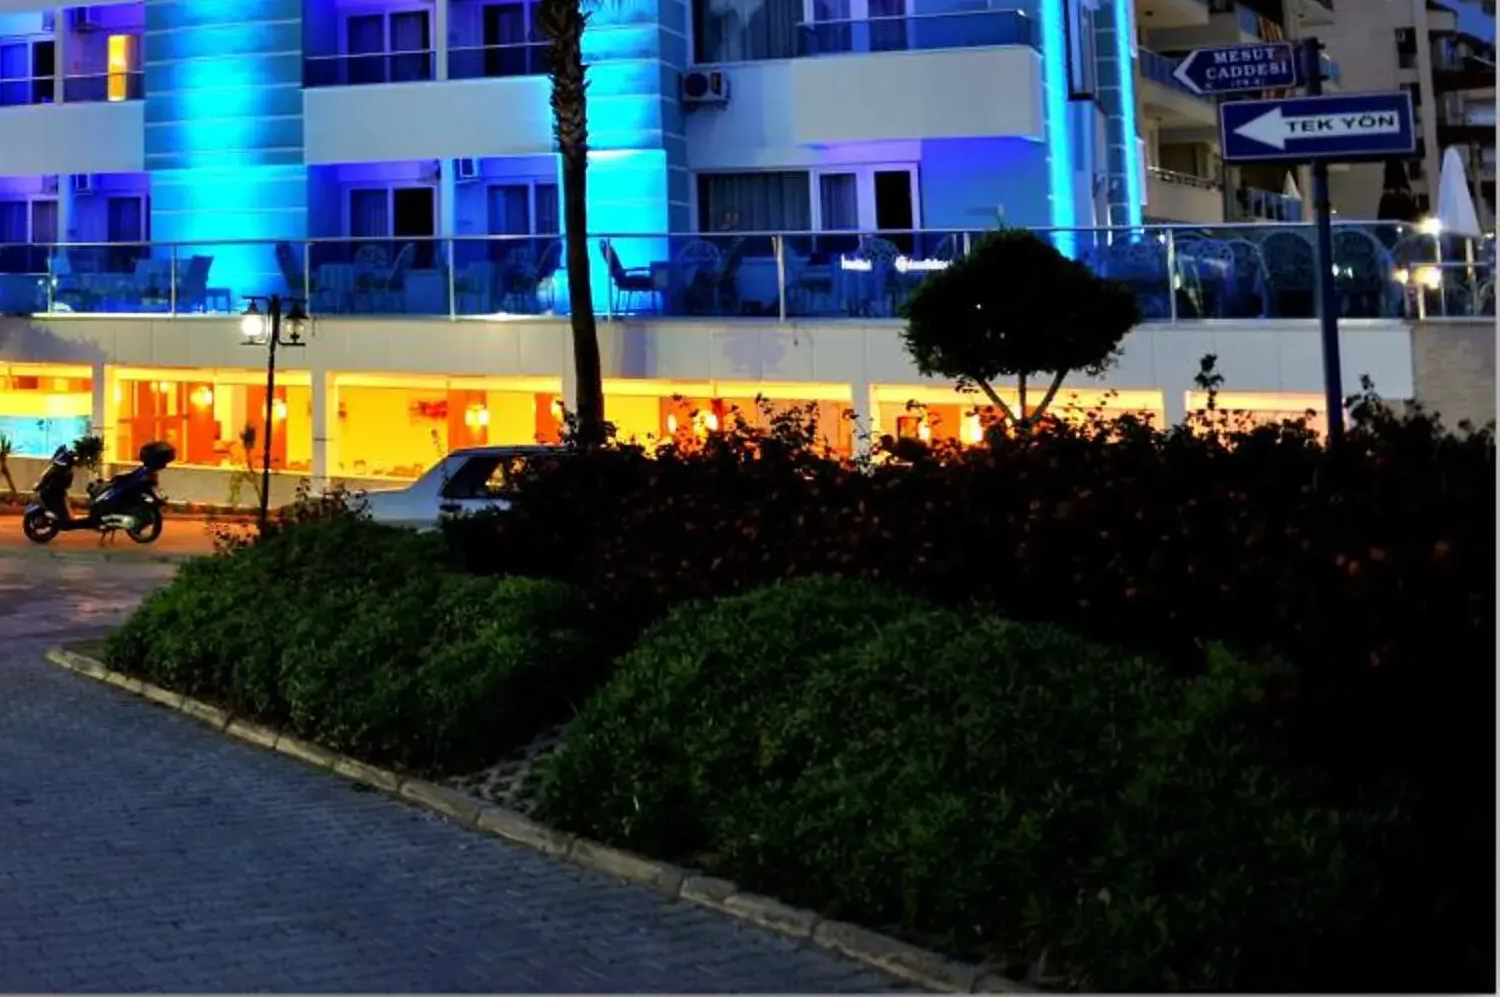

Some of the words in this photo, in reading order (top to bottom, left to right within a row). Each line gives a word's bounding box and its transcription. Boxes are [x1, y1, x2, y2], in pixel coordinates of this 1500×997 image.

[1213, 47, 1276, 63] MESUT
[1285, 117, 1333, 133] TEK
[1342, 110, 1395, 131] YÖN
